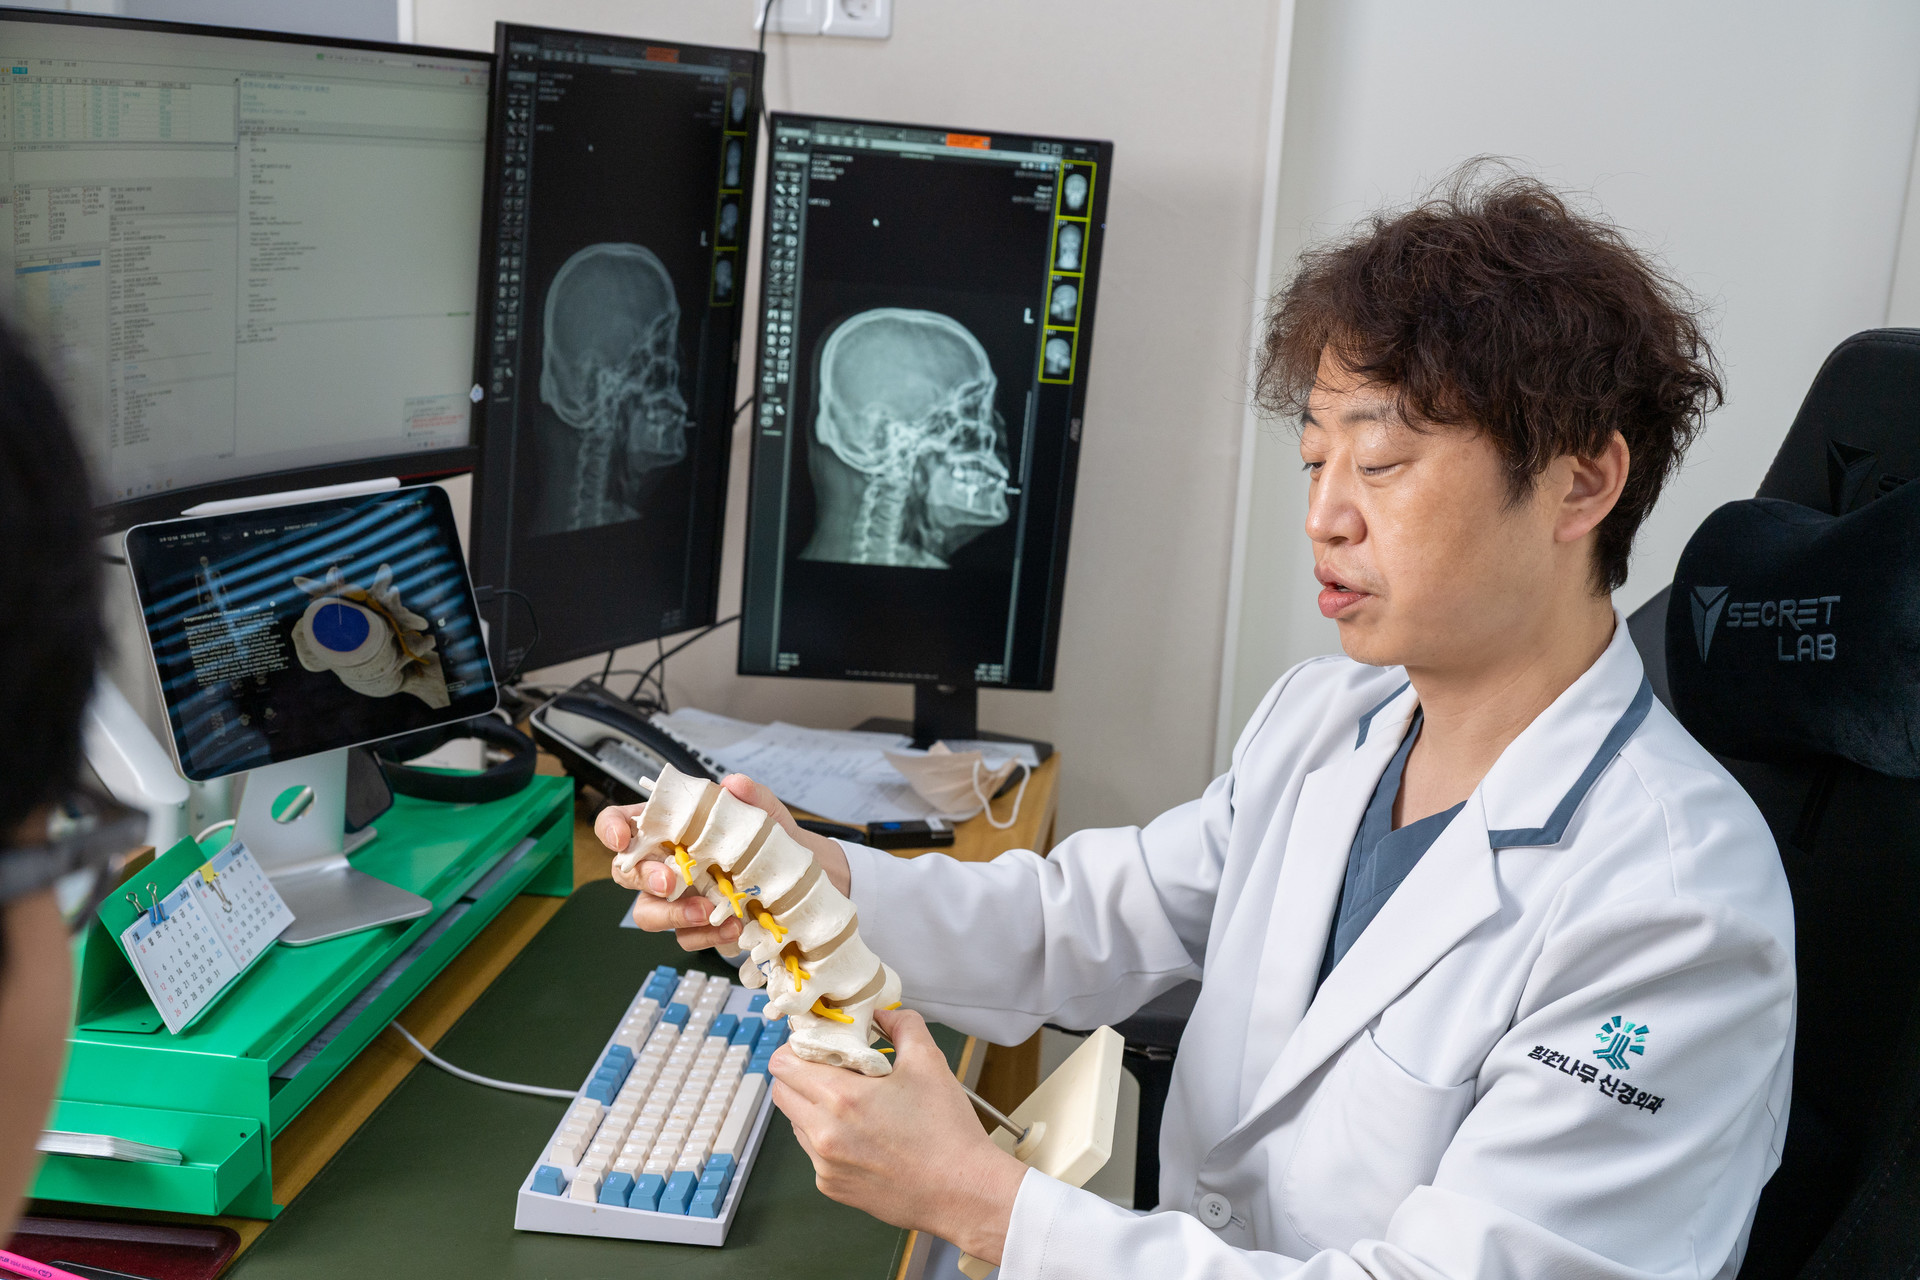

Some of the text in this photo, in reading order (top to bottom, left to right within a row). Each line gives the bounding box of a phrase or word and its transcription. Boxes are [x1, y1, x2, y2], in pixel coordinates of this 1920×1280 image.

[1022, 308, 1036, 324] L
[1726, 596, 1840, 630] SECRET
[1777, 634, 1837, 662] LAB
[180, 888, 190, 901] July
[179, 929, 184, 937] 2
[187, 922, 192, 930] 3
[154, 926, 208, 979] 5 6 7 8 9 10 11
[160, 982, 168, 992] 12
[168, 974, 176, 984] 13
[176, 967, 184, 976] 14
[184, 960, 192, 968] 15
[192, 952, 199, 962] 16
[200, 944, 206, 954] 17
[168, 948, 224, 1004] 19 20 21 22 23 24 25
[174, 968, 221, 1018] 26 27 28 29 30 31
[1528, 1045, 1666, 1114] 힘찬나무 신경외과
